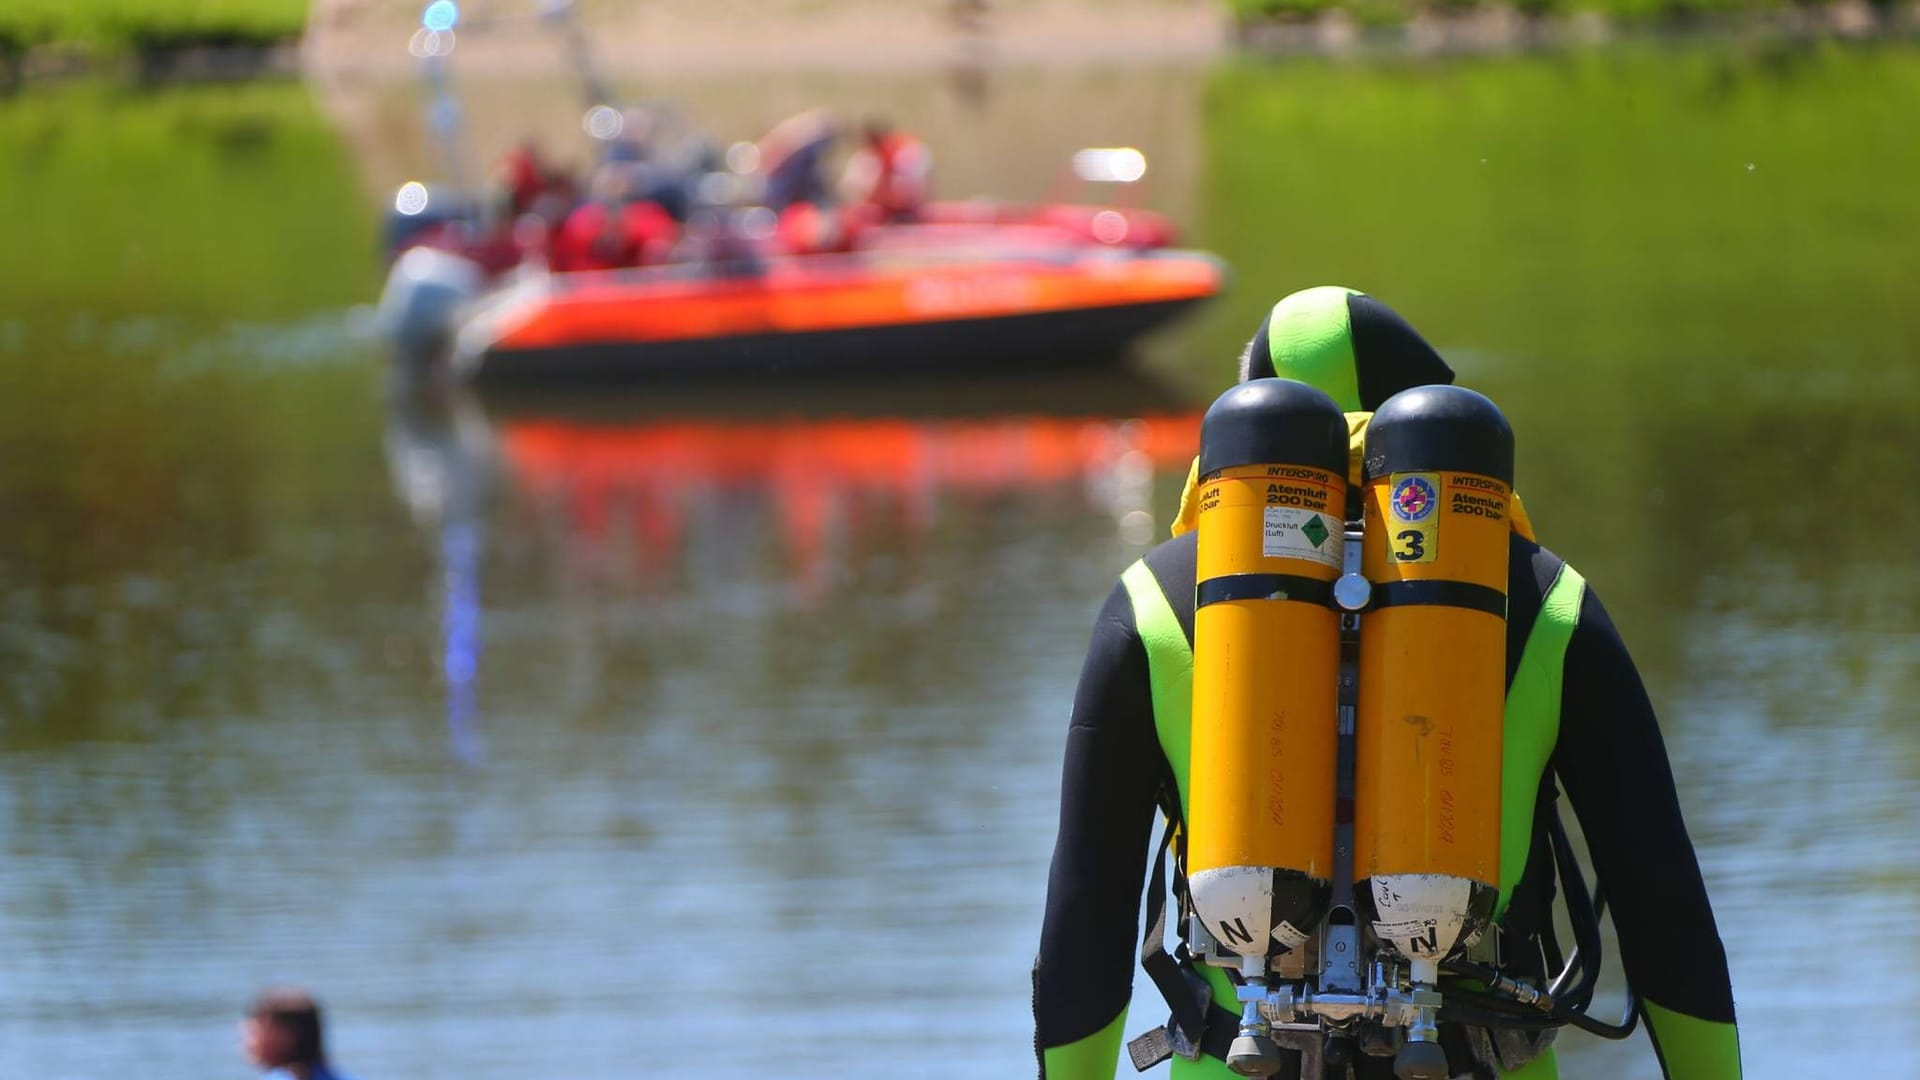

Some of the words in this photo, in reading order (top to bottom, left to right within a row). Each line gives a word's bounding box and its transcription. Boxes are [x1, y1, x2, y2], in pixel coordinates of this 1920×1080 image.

[1267, 467, 1328, 482] INTERSPIRO
[1267, 483, 1327, 499] Atemluft
[1267, 494, 1301, 505] 200
[1303, 498, 1328, 510] bar
[1453, 503, 1484, 516] 200
[1265, 521, 1298, 530] Druckluft
[1395, 529, 1424, 561] 3
[1219, 917, 1254, 946] N
[1410, 927, 1439, 953] N
